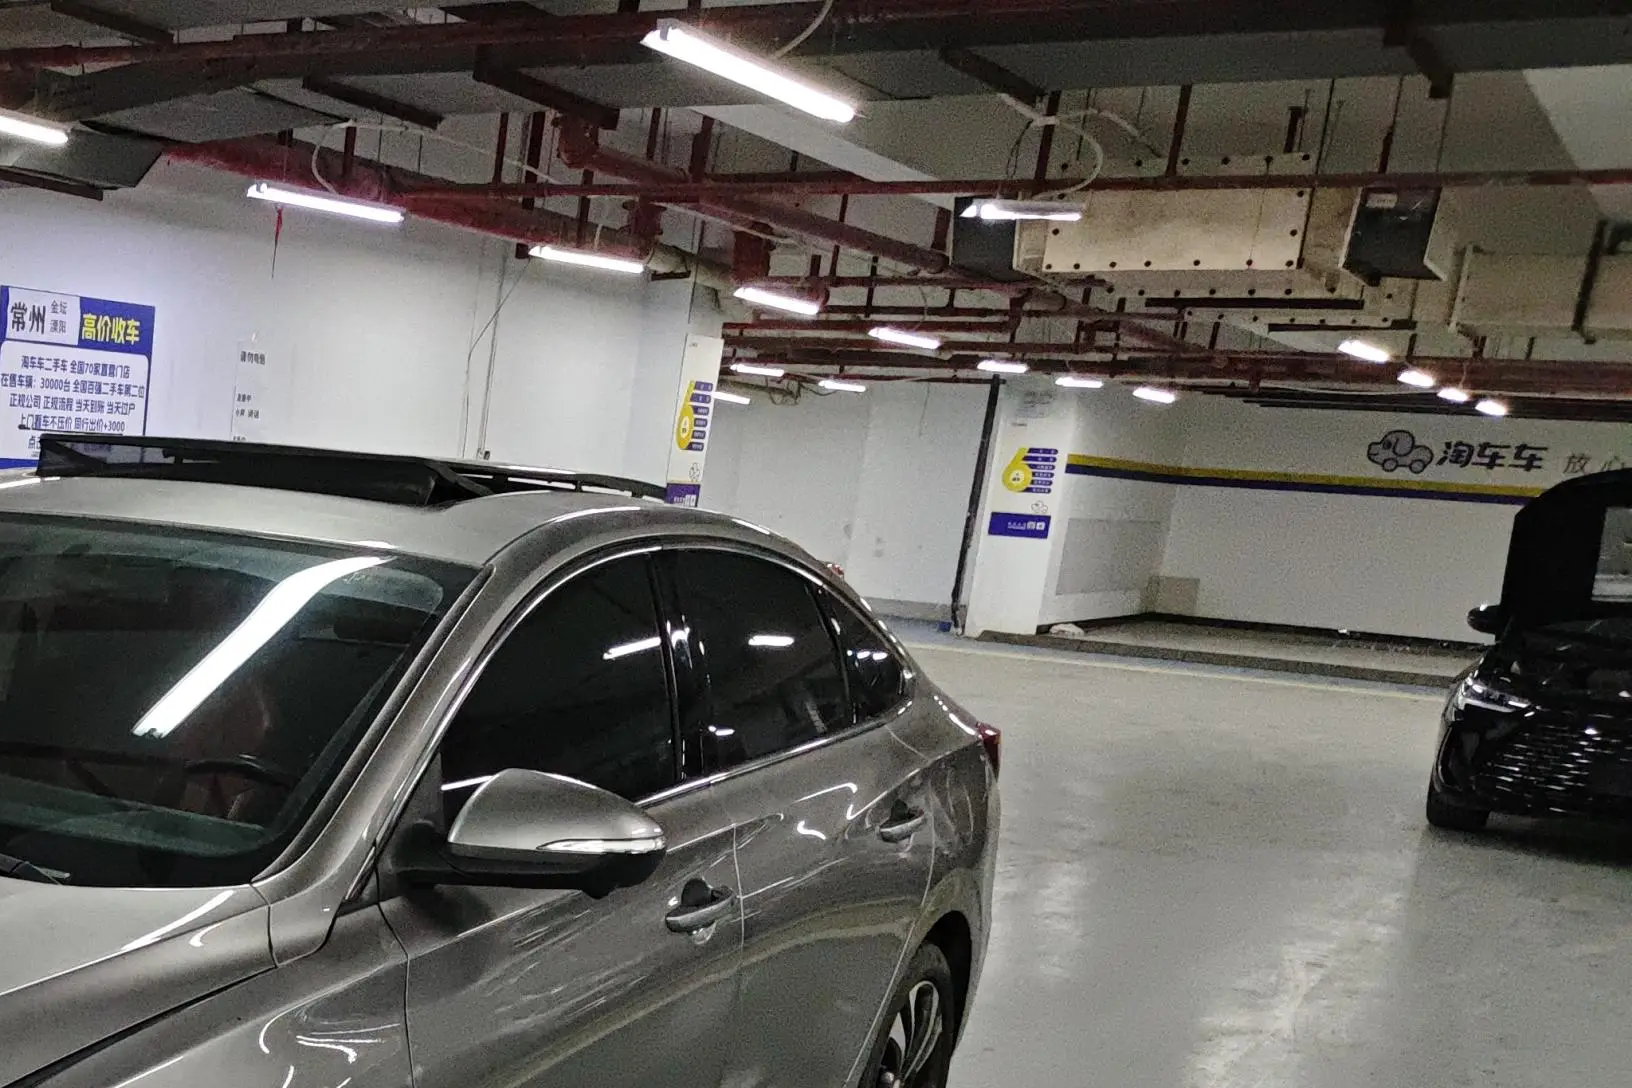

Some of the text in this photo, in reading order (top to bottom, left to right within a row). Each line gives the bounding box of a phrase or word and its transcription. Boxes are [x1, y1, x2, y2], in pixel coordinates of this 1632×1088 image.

[10, 301, 46, 335] 常州
[81, 312, 141, 345] 高价收车
[20, 355, 68, 373] 淘车车二手车
[9, 392, 42, 409] 正规公司
[42, 395, 74, 412] 正规流程
[106, 400, 136, 416] 当天过户
[1435, 440, 1549, 472] 淘车车
